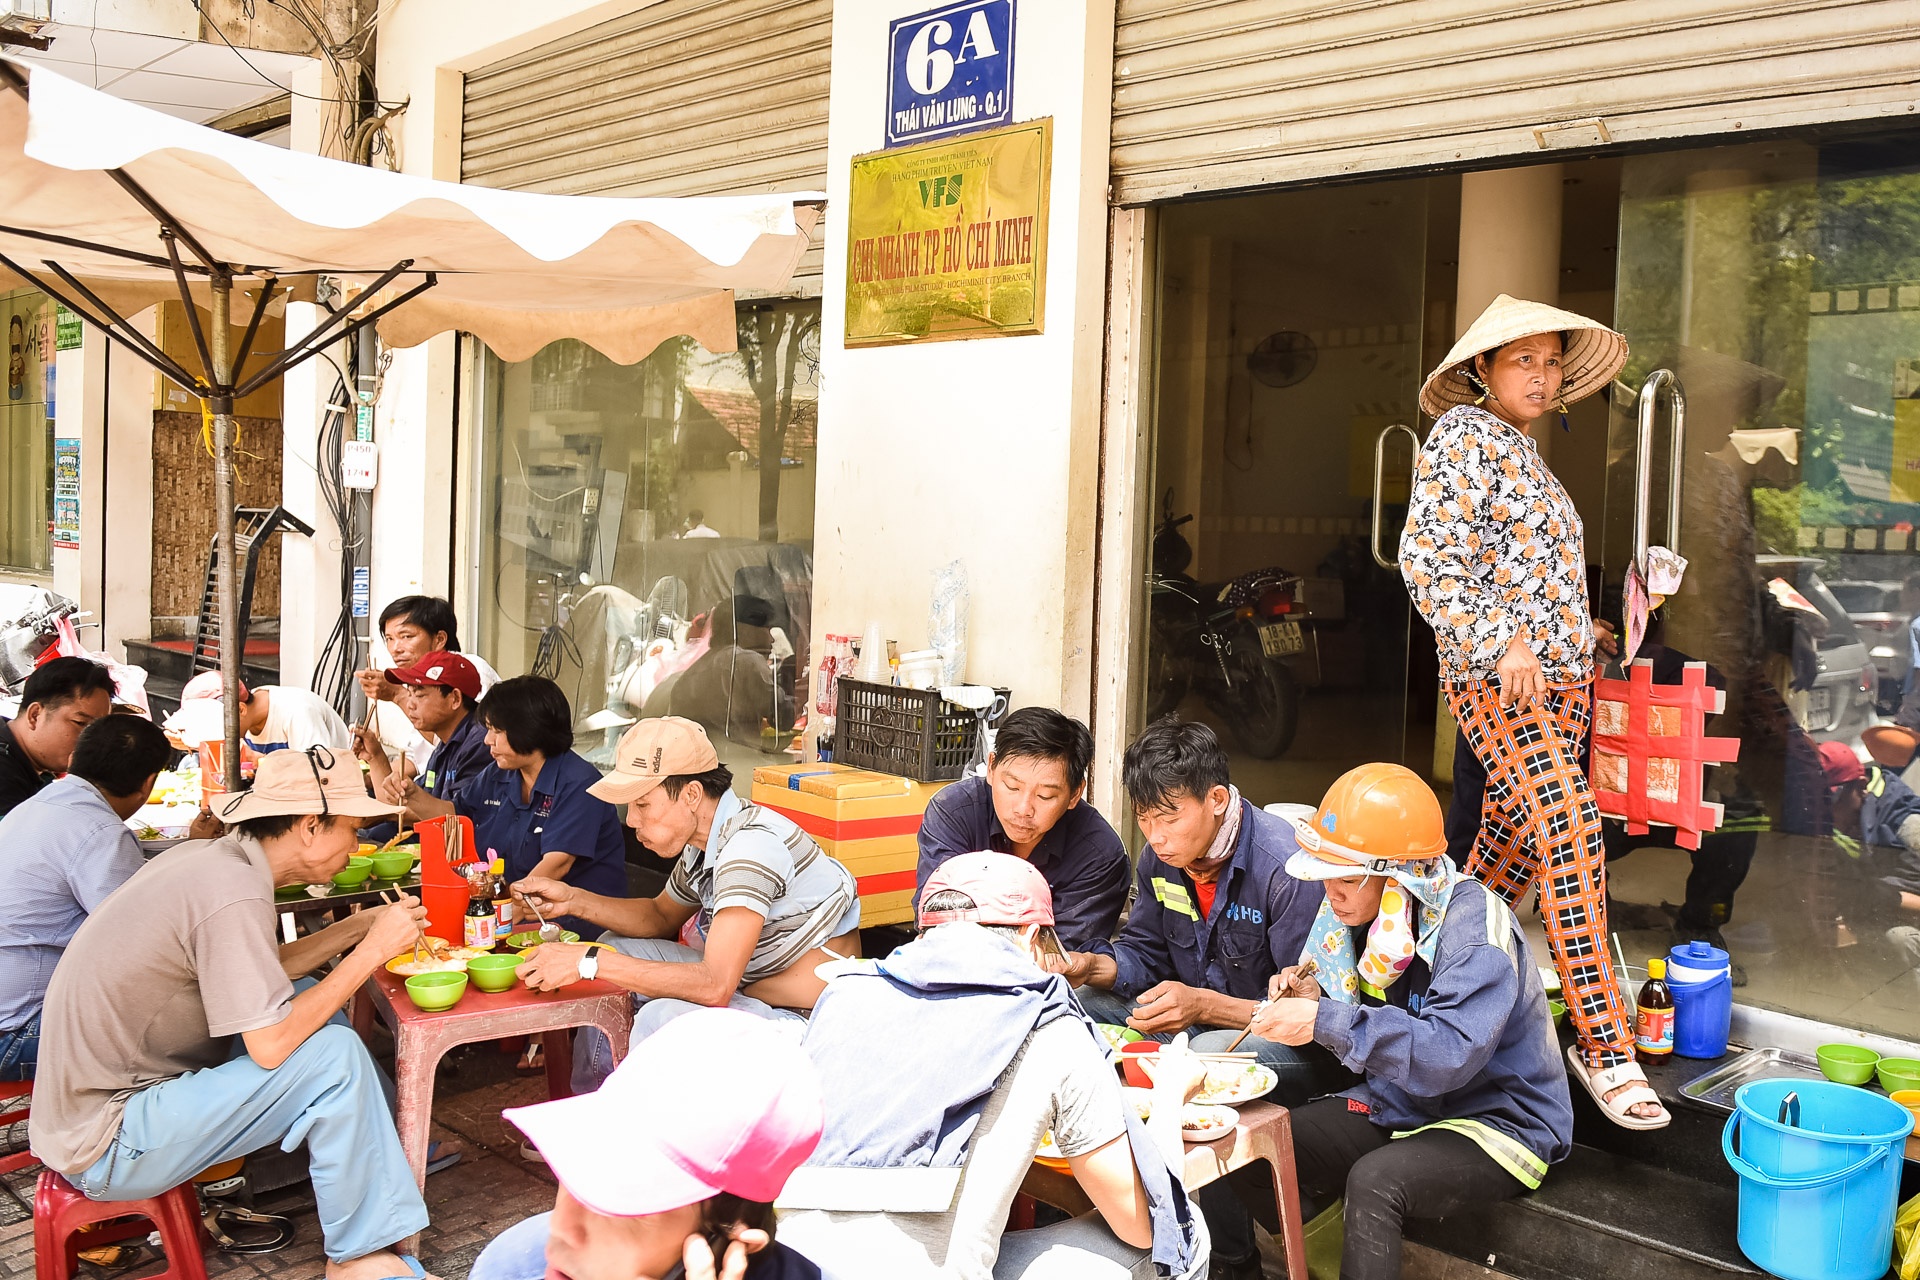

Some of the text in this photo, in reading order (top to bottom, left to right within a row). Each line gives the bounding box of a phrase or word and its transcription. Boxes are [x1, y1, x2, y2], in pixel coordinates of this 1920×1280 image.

[906, 10, 999, 95] 6A
[895, 103, 920, 133] THÁI
[923, 99, 945, 128] VĂN
[947, 95, 977, 123] LUNG
[985, 89, 1003, 116] Q.1
[912, 167, 929, 179] PHIM
[976, 156, 993, 168] NAM
[918, 174, 963, 209] VFS
[853, 203, 1033, 284] CHI NHÁNH TP HỒ CHÍ MINH
[985, 275, 1002, 285] CITY
[1003, 272, 1031, 282] BRANCH
[653, 747, 662, 774] adidas
